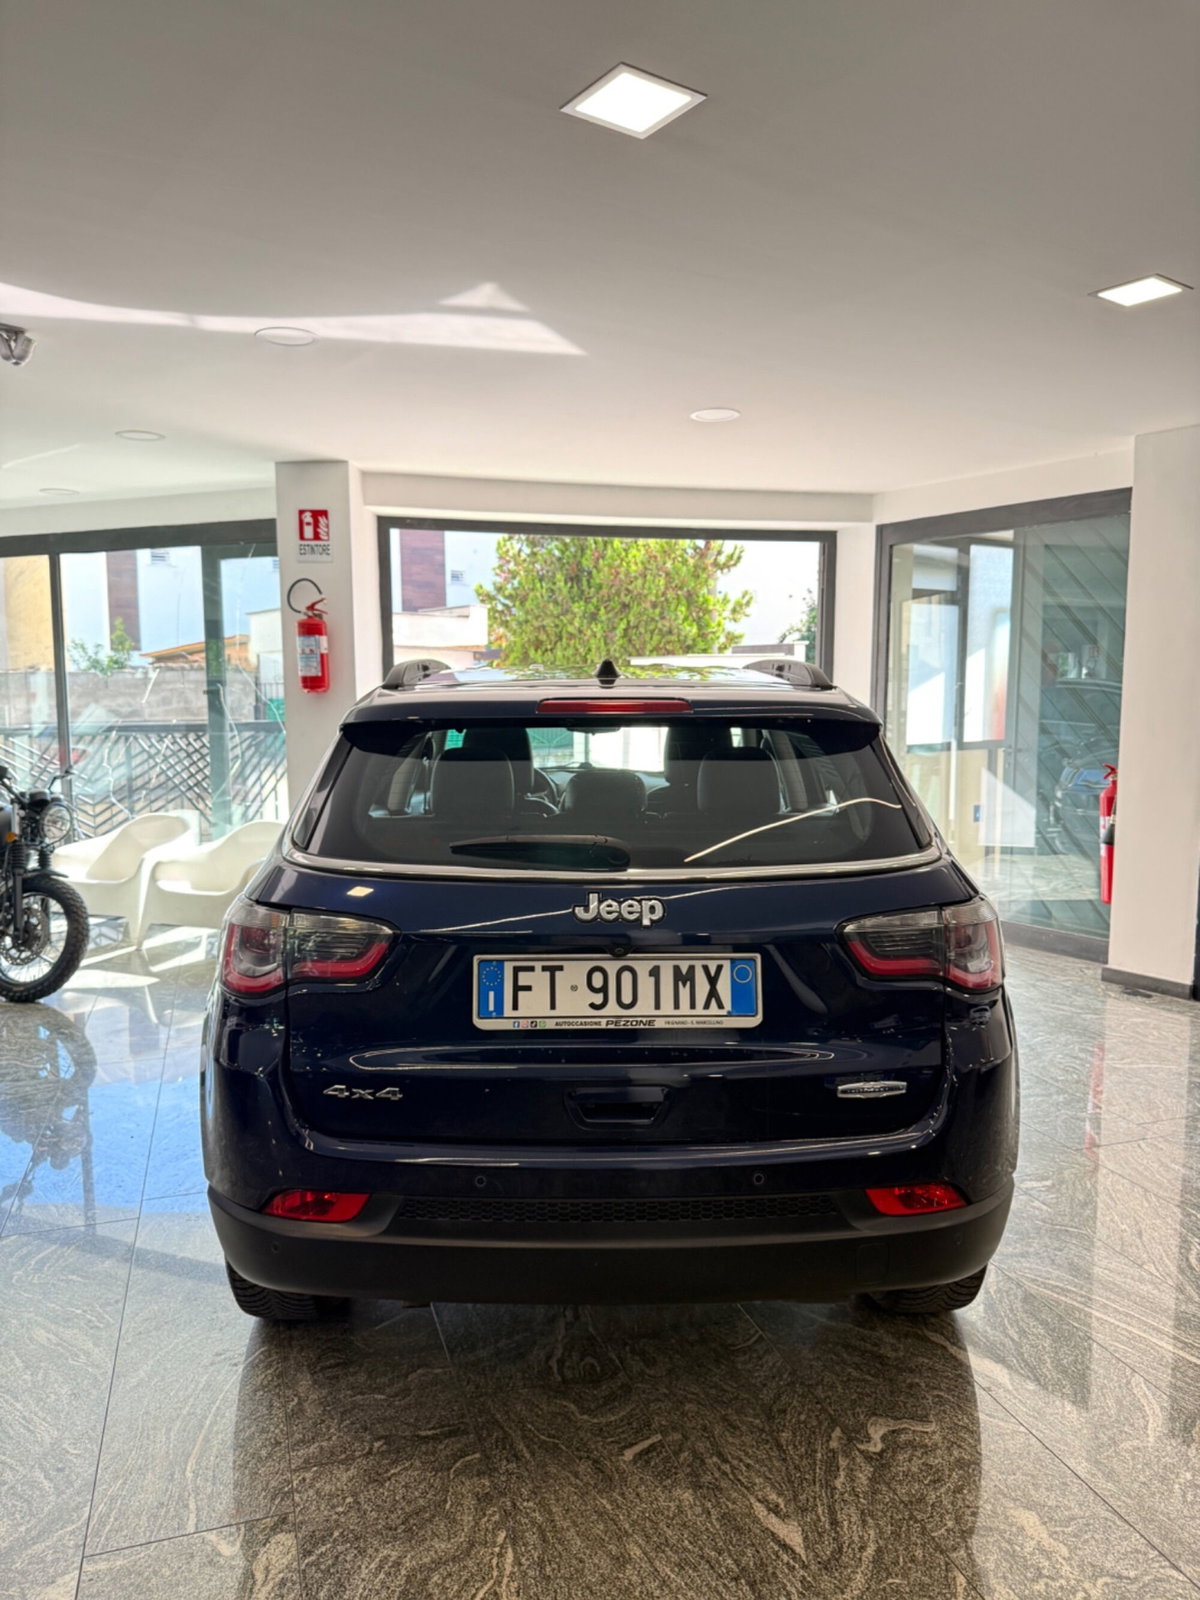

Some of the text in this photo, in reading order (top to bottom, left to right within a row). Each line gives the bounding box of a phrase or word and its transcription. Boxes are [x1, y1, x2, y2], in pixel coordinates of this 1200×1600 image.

[298, 543, 330, 555] ESTINTORE
[574, 892, 664, 926] Jeep
[511, 963, 726, 1011] FT 901MX
[605, 1018, 656, 1027] PEZONE
[322, 1084, 403, 1101] 4x4
